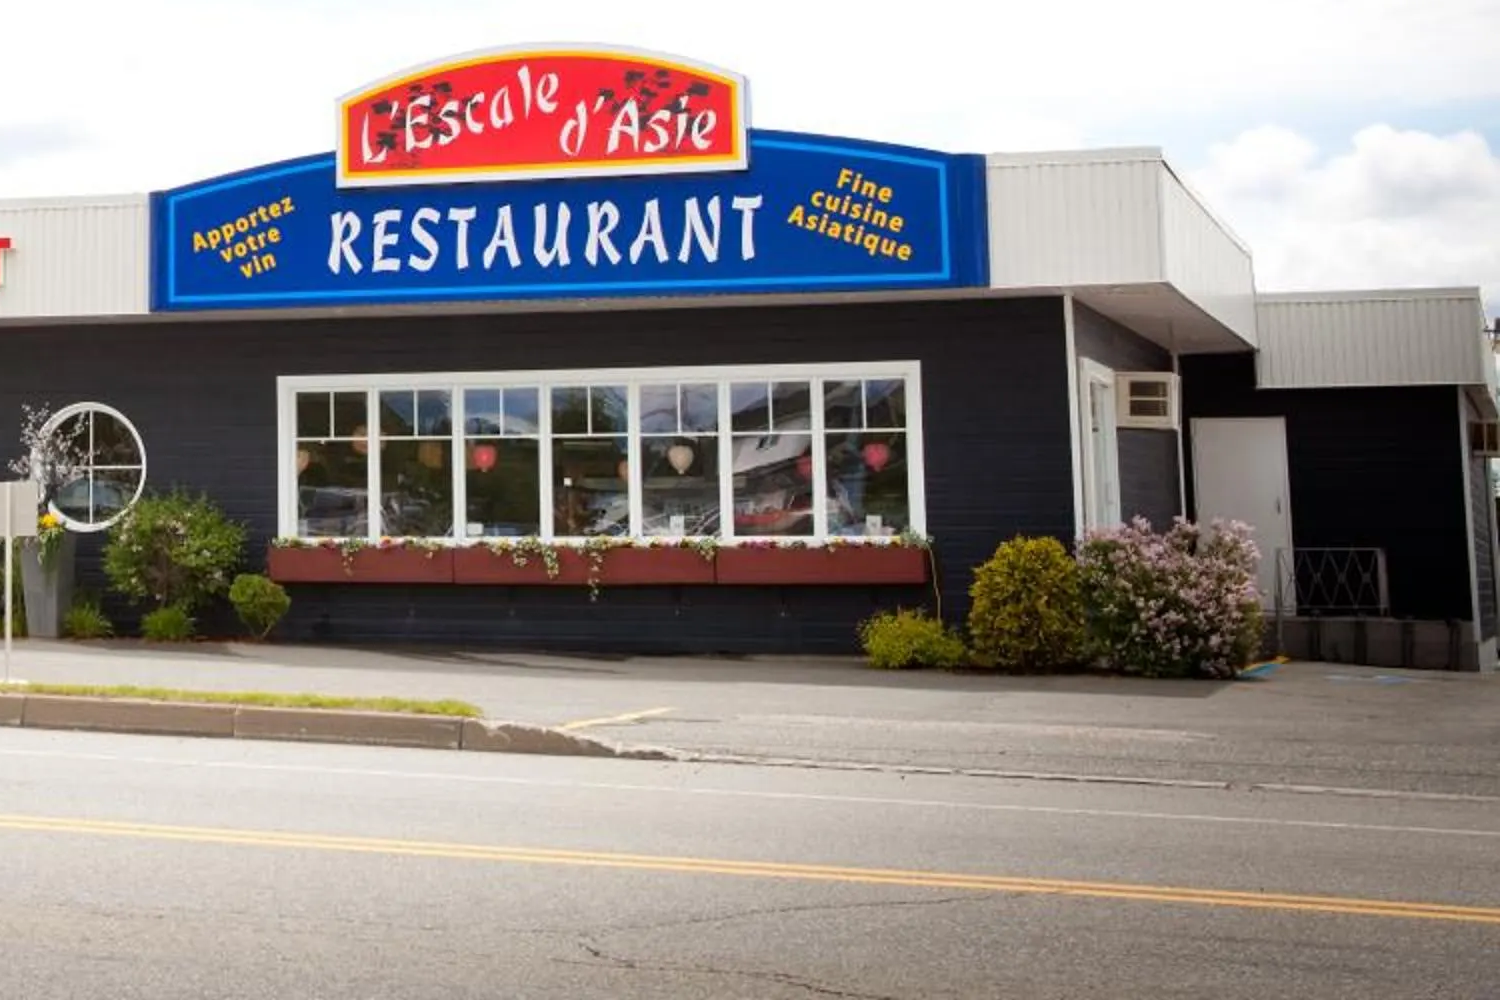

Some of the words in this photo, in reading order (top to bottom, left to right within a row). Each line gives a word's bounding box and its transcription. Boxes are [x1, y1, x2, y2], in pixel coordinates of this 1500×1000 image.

[361, 64, 558, 164] L'Escale
[560, 95, 716, 156] d'Asie
[836, 167, 892, 203] Fine
[193, 196, 295, 253] Apportez
[326, 194, 764, 275] RESTAURANT
[787, 204, 912, 261] Asiatique
[810, 190, 903, 233] cuisine
[220, 227, 281, 263] votre
[240, 253, 276, 279] vin
